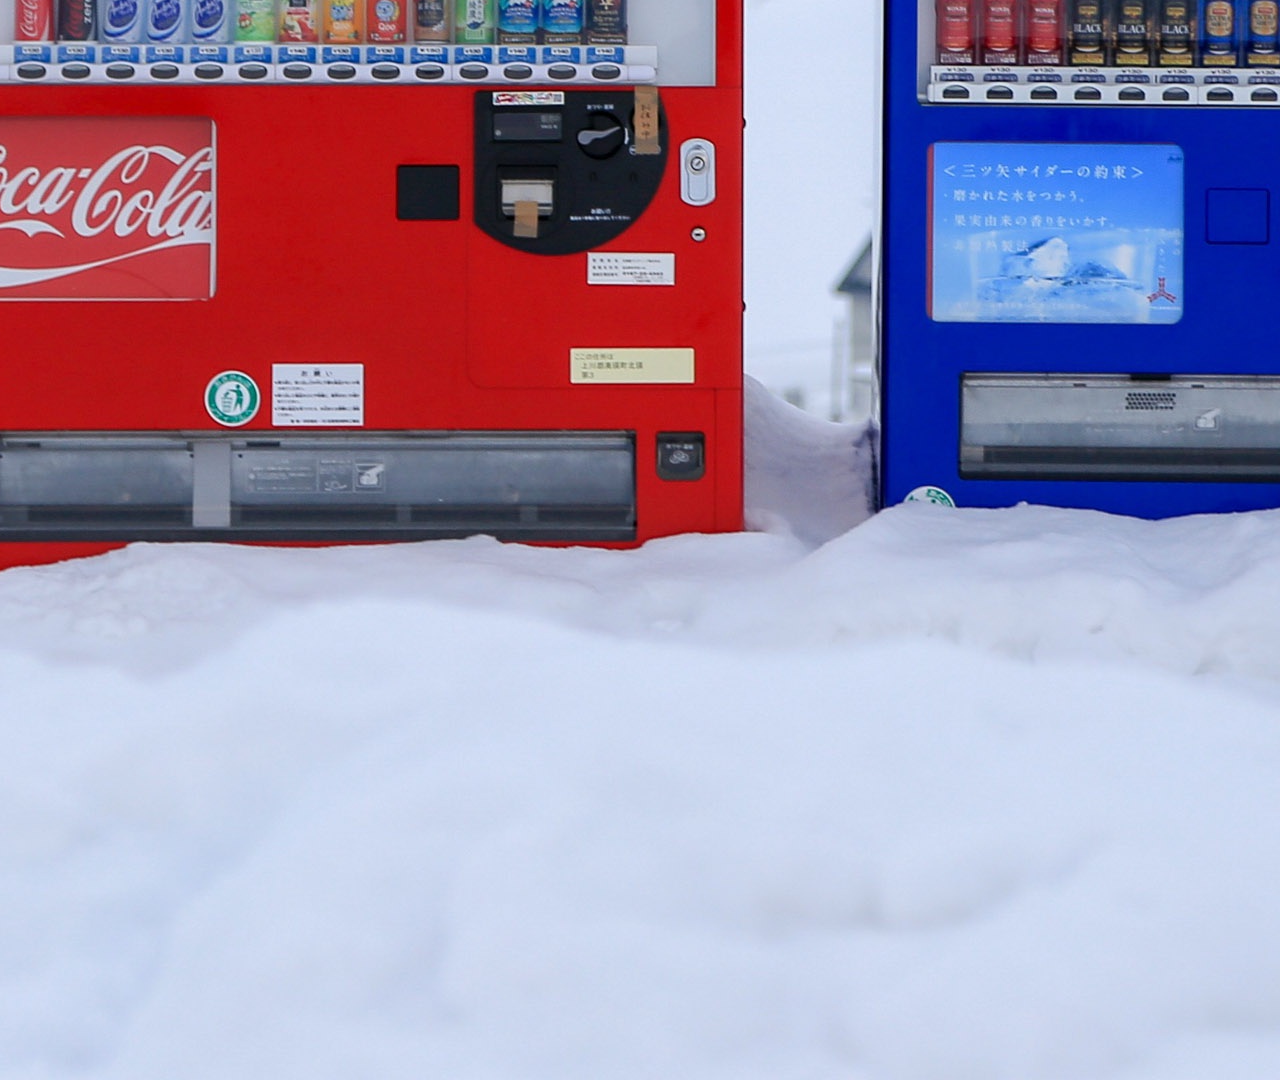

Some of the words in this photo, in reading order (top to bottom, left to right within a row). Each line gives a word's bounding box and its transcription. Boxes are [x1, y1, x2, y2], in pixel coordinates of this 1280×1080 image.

[1073, 24, 1102, 33] BLACK
[1118, 24, 1146, 34] BLACK
[1161, 24, 1190, 34] BLACK
